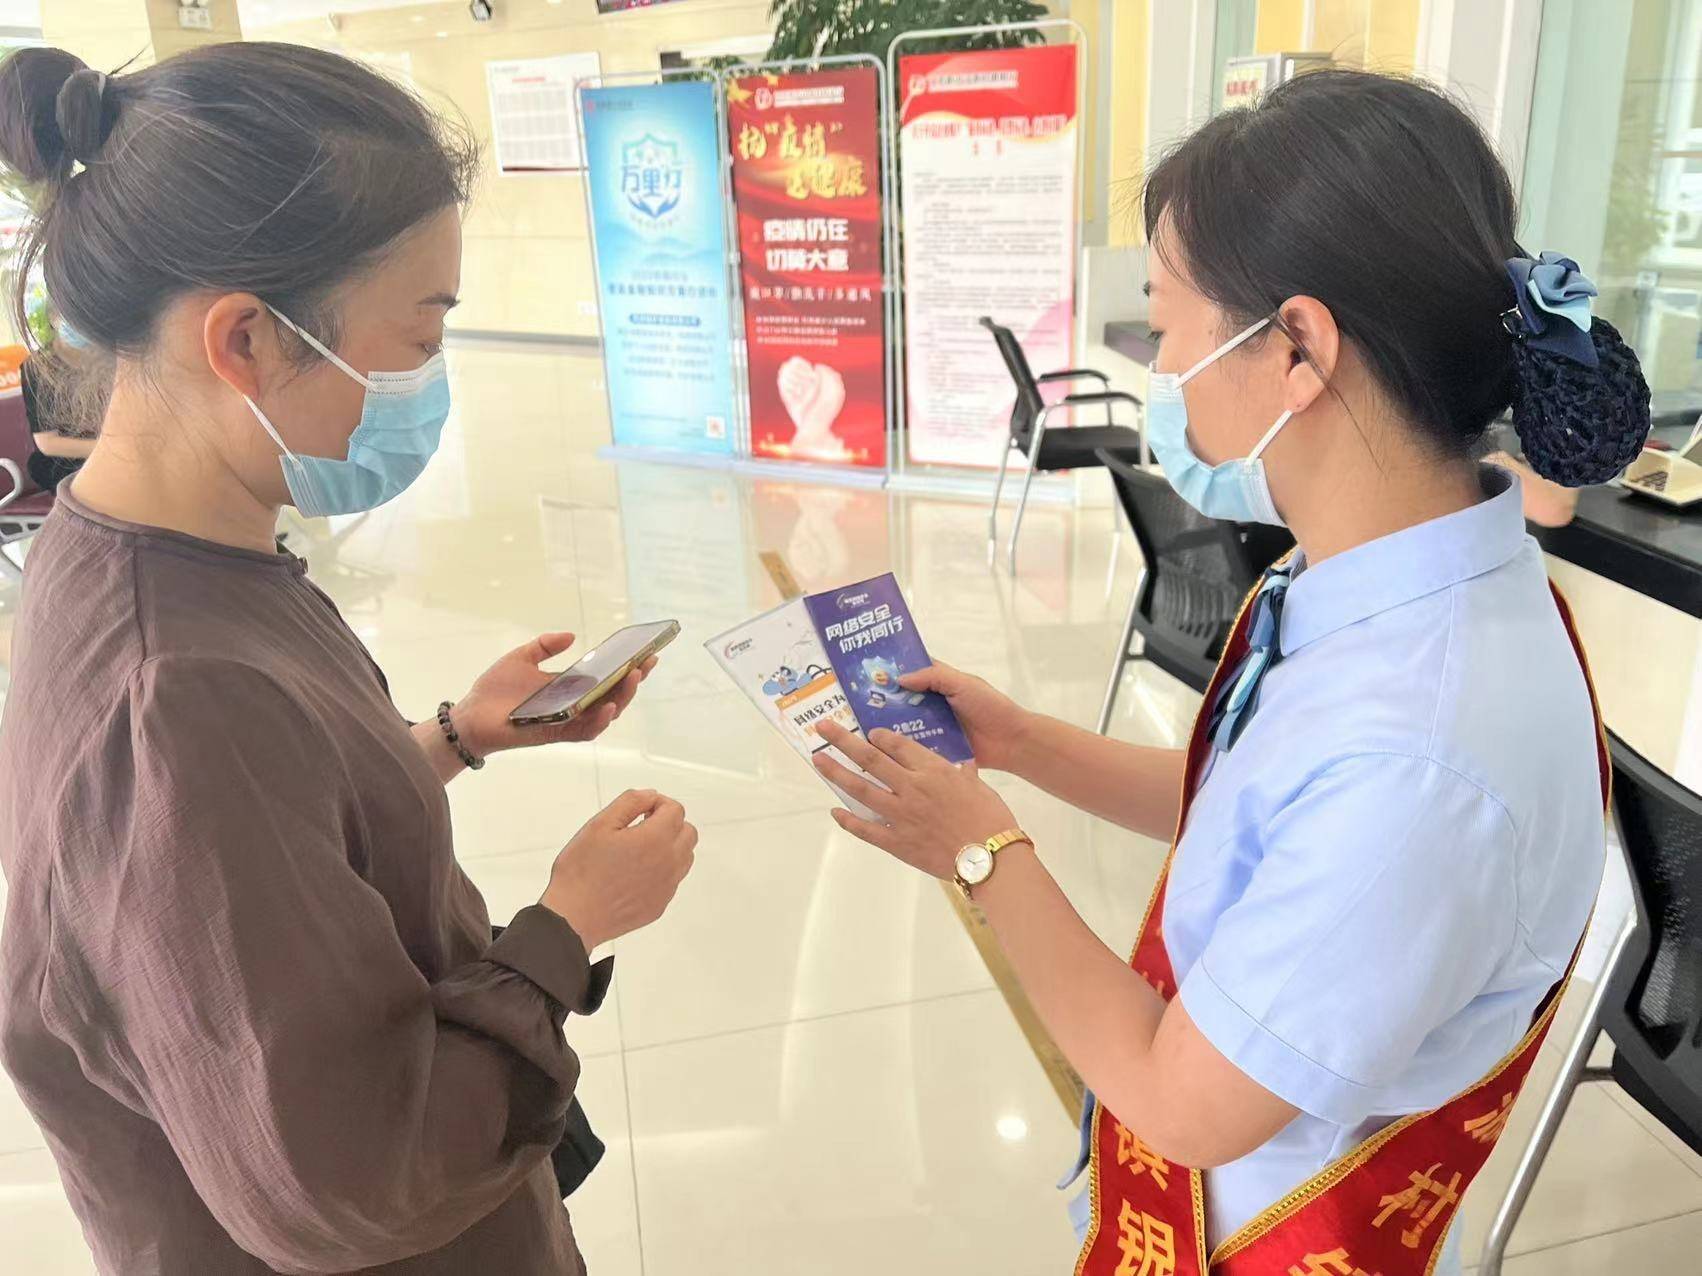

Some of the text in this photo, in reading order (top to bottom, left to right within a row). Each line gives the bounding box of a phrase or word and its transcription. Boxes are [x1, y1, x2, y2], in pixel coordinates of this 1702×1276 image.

[763, 217, 849, 242] 疫情仍在
[825, 603, 892, 641] 网络安全
[839, 615, 904, 654] 你我同行
